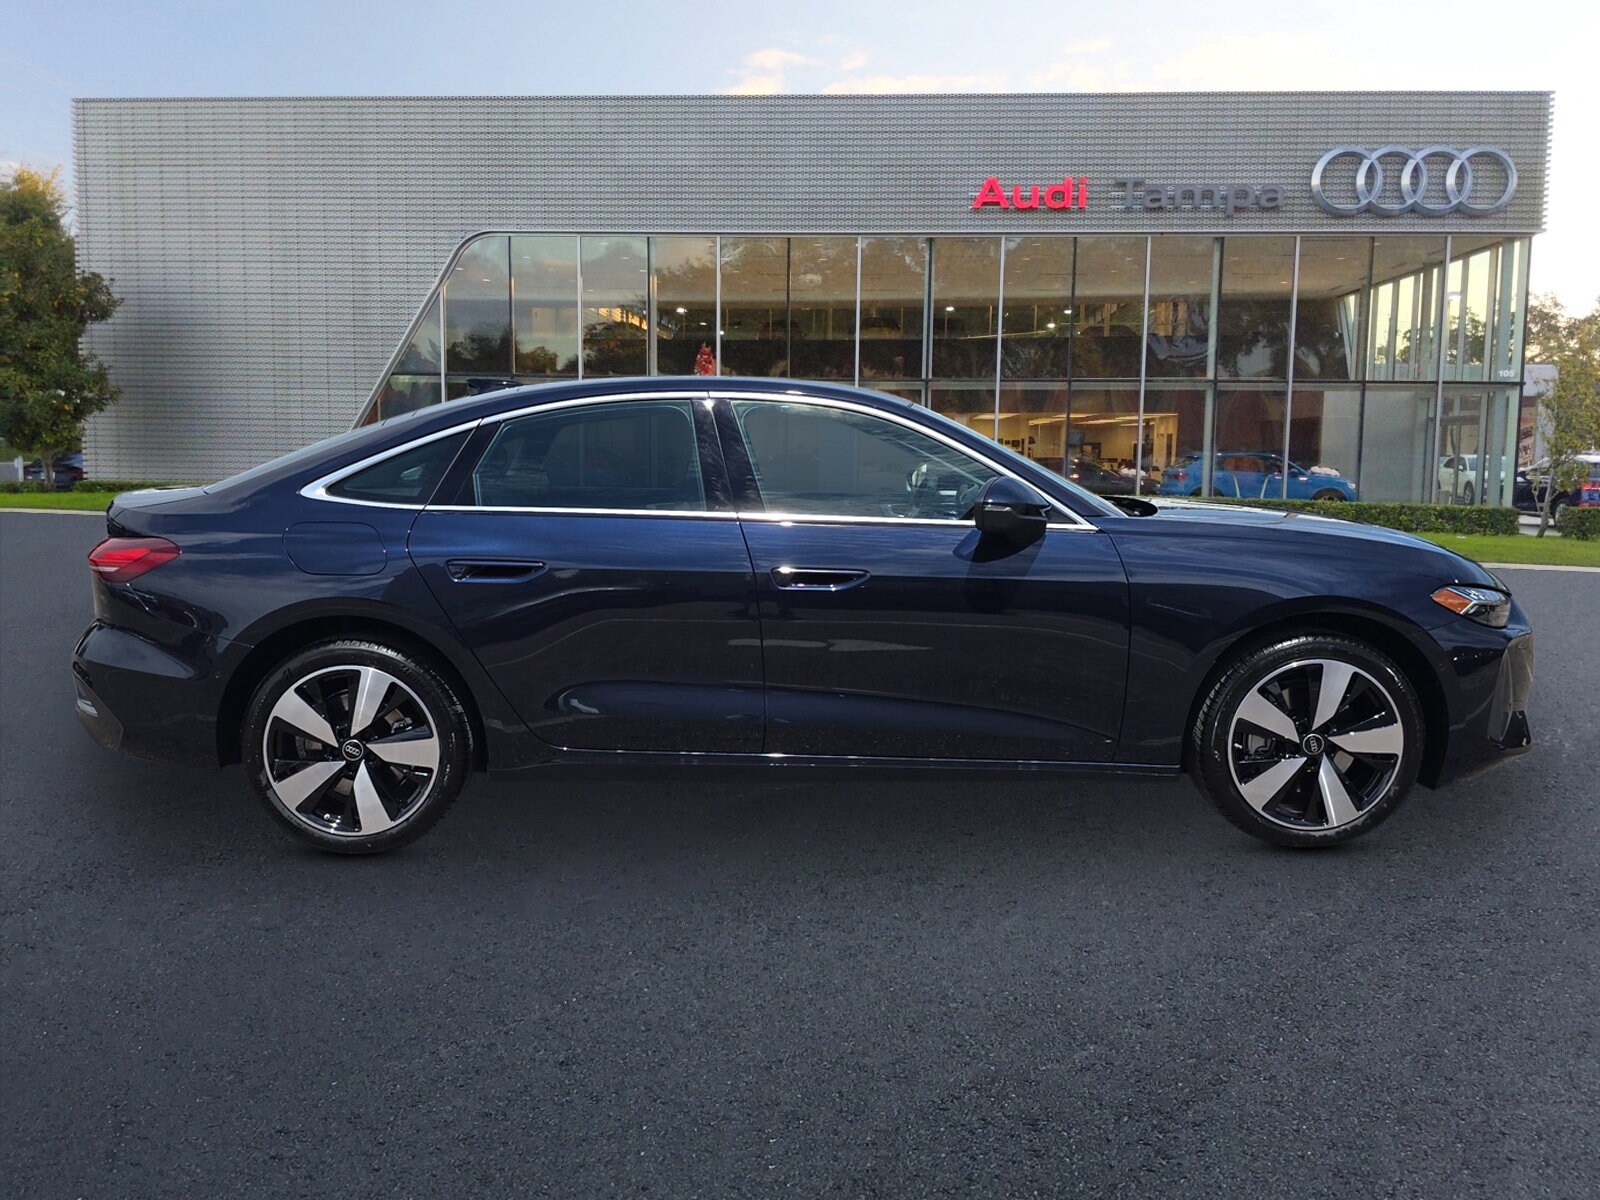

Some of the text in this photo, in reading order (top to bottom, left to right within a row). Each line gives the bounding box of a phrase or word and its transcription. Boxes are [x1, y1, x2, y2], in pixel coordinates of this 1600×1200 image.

[972, 176, 1286, 217] Audi Tampa
[1498, 369, 1515, 378] 105
